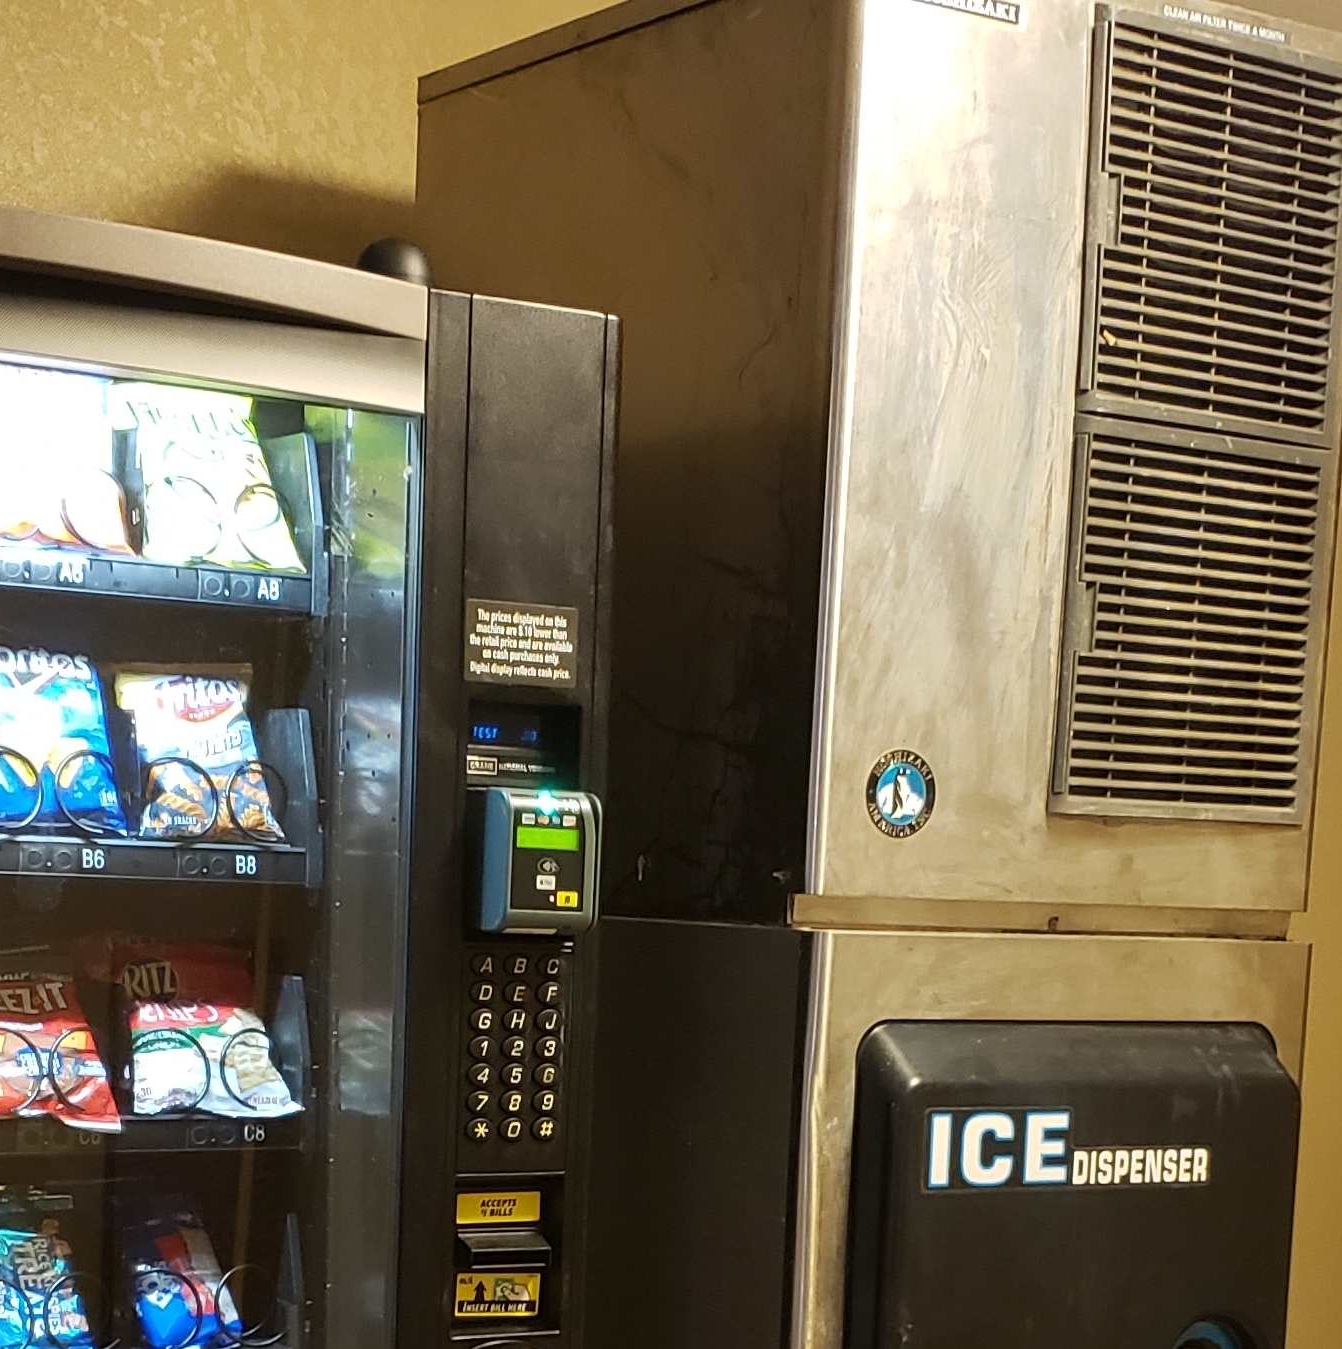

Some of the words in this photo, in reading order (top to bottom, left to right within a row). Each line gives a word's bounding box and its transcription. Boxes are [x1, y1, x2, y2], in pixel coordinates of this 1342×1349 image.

[258, 577, 280, 600] A8
[477, 607, 490, 622] The
[491, 609, 512, 626] prices
[513, 611, 544, 628] displayed
[545, 616, 554, 627] on
[554, 615, 567, 628] this
[476, 623, 505, 635] machine
[505, 626, 518, 637] are
[533, 627, 552, 639] lower
[552, 628, 568, 640] than
[469, 633, 481, 646] the
[482, 635, 500, 647] retail
[500, 637, 517, 650] price
[518, 638, 532, 650] and
[532, 641, 543, 651] are
[544, 641, 573, 653] available
[492, 648, 508, 660] cash
[509, 650, 544, 663] purchases
[470, 660, 490, 675] Digital
[491, 662, 513, 677] display
[537, 667, 553, 678] cash
[473, 726, 499, 739] TEST
[82, 848, 105, 870] B6
[235, 854, 257, 876] B8
[479, 957, 493, 974] A
[513, 957, 527, 975] B
[546, 958, 559, 975] C
[122, 960, 177, 1000] RITZ
[479, 984, 493, 1001] D
[512, 985, 526, 1002] E
[545, 985, 558, 1002] F
[478, 1012, 492, 1030] G
[510, 1012, 526, 1030] H
[545, 1013, 558, 1031] J
[480, 1040, 489, 1057] 1
[510, 1040, 525, 1057] 2
[543, 1040, 556, 1057] 3
[477, 1067, 490, 1084] 4
[510, 1067, 523, 1084] 5
[542, 1067, 555, 1084] 6
[476, 1094, 489, 1111] 7
[509, 1094, 522, 1112] 8
[541, 1093, 554, 1111] 9
[244, 1123, 266, 1144] C8
[507, 1121, 522, 1138] 0
[928, 1111, 1070, 1188] ICE
[1072, 1147, 1209, 1185] DISPENSER
[480, 1198, 518, 1208] ACCEPTS
[489, 1208, 513, 1217] BILLS
[462, 1302, 489, 1312] INSERT
[490, 1304, 506, 1312] BILL
[507, 1302, 528, 1312] HERE
